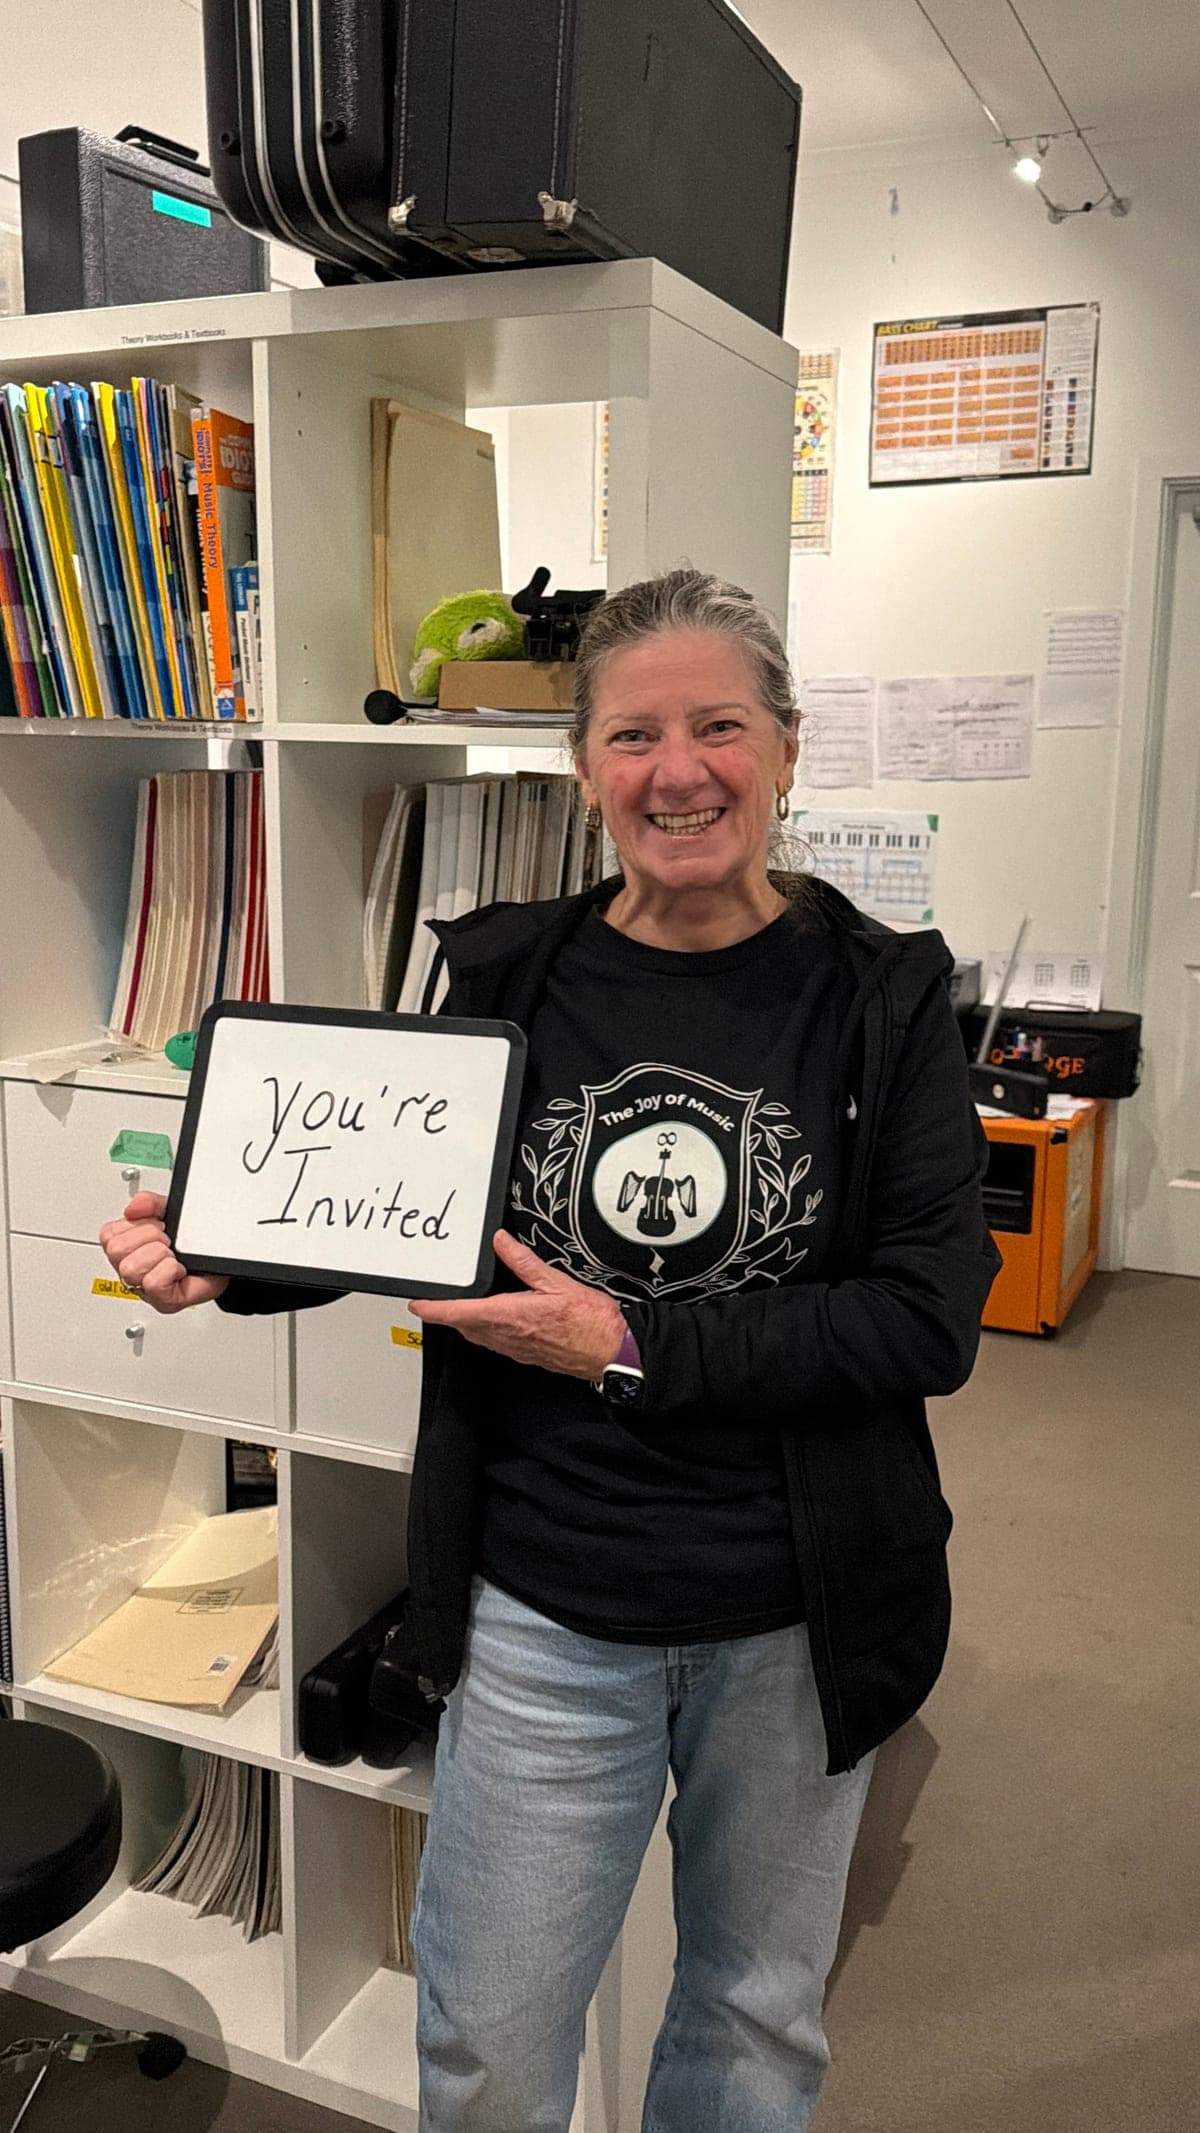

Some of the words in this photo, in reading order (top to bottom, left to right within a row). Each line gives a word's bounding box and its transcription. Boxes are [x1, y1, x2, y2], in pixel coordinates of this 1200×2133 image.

[121, 335, 144, 345] Theory
[145, 332, 183, 343] Workbooks
[191, 328, 227, 338] Textbooks
[903, 320, 938, 334] CHART
[203, 481, 214, 520] Music
[207, 522, 218, 570] Theory
[598, 1106, 635, 1127] The
[634, 1094, 662, 1113] Joy
[664, 1093, 687, 1106] of
[686, 1097, 736, 1132] Music
[257, 1146, 457, 1240] Invited
